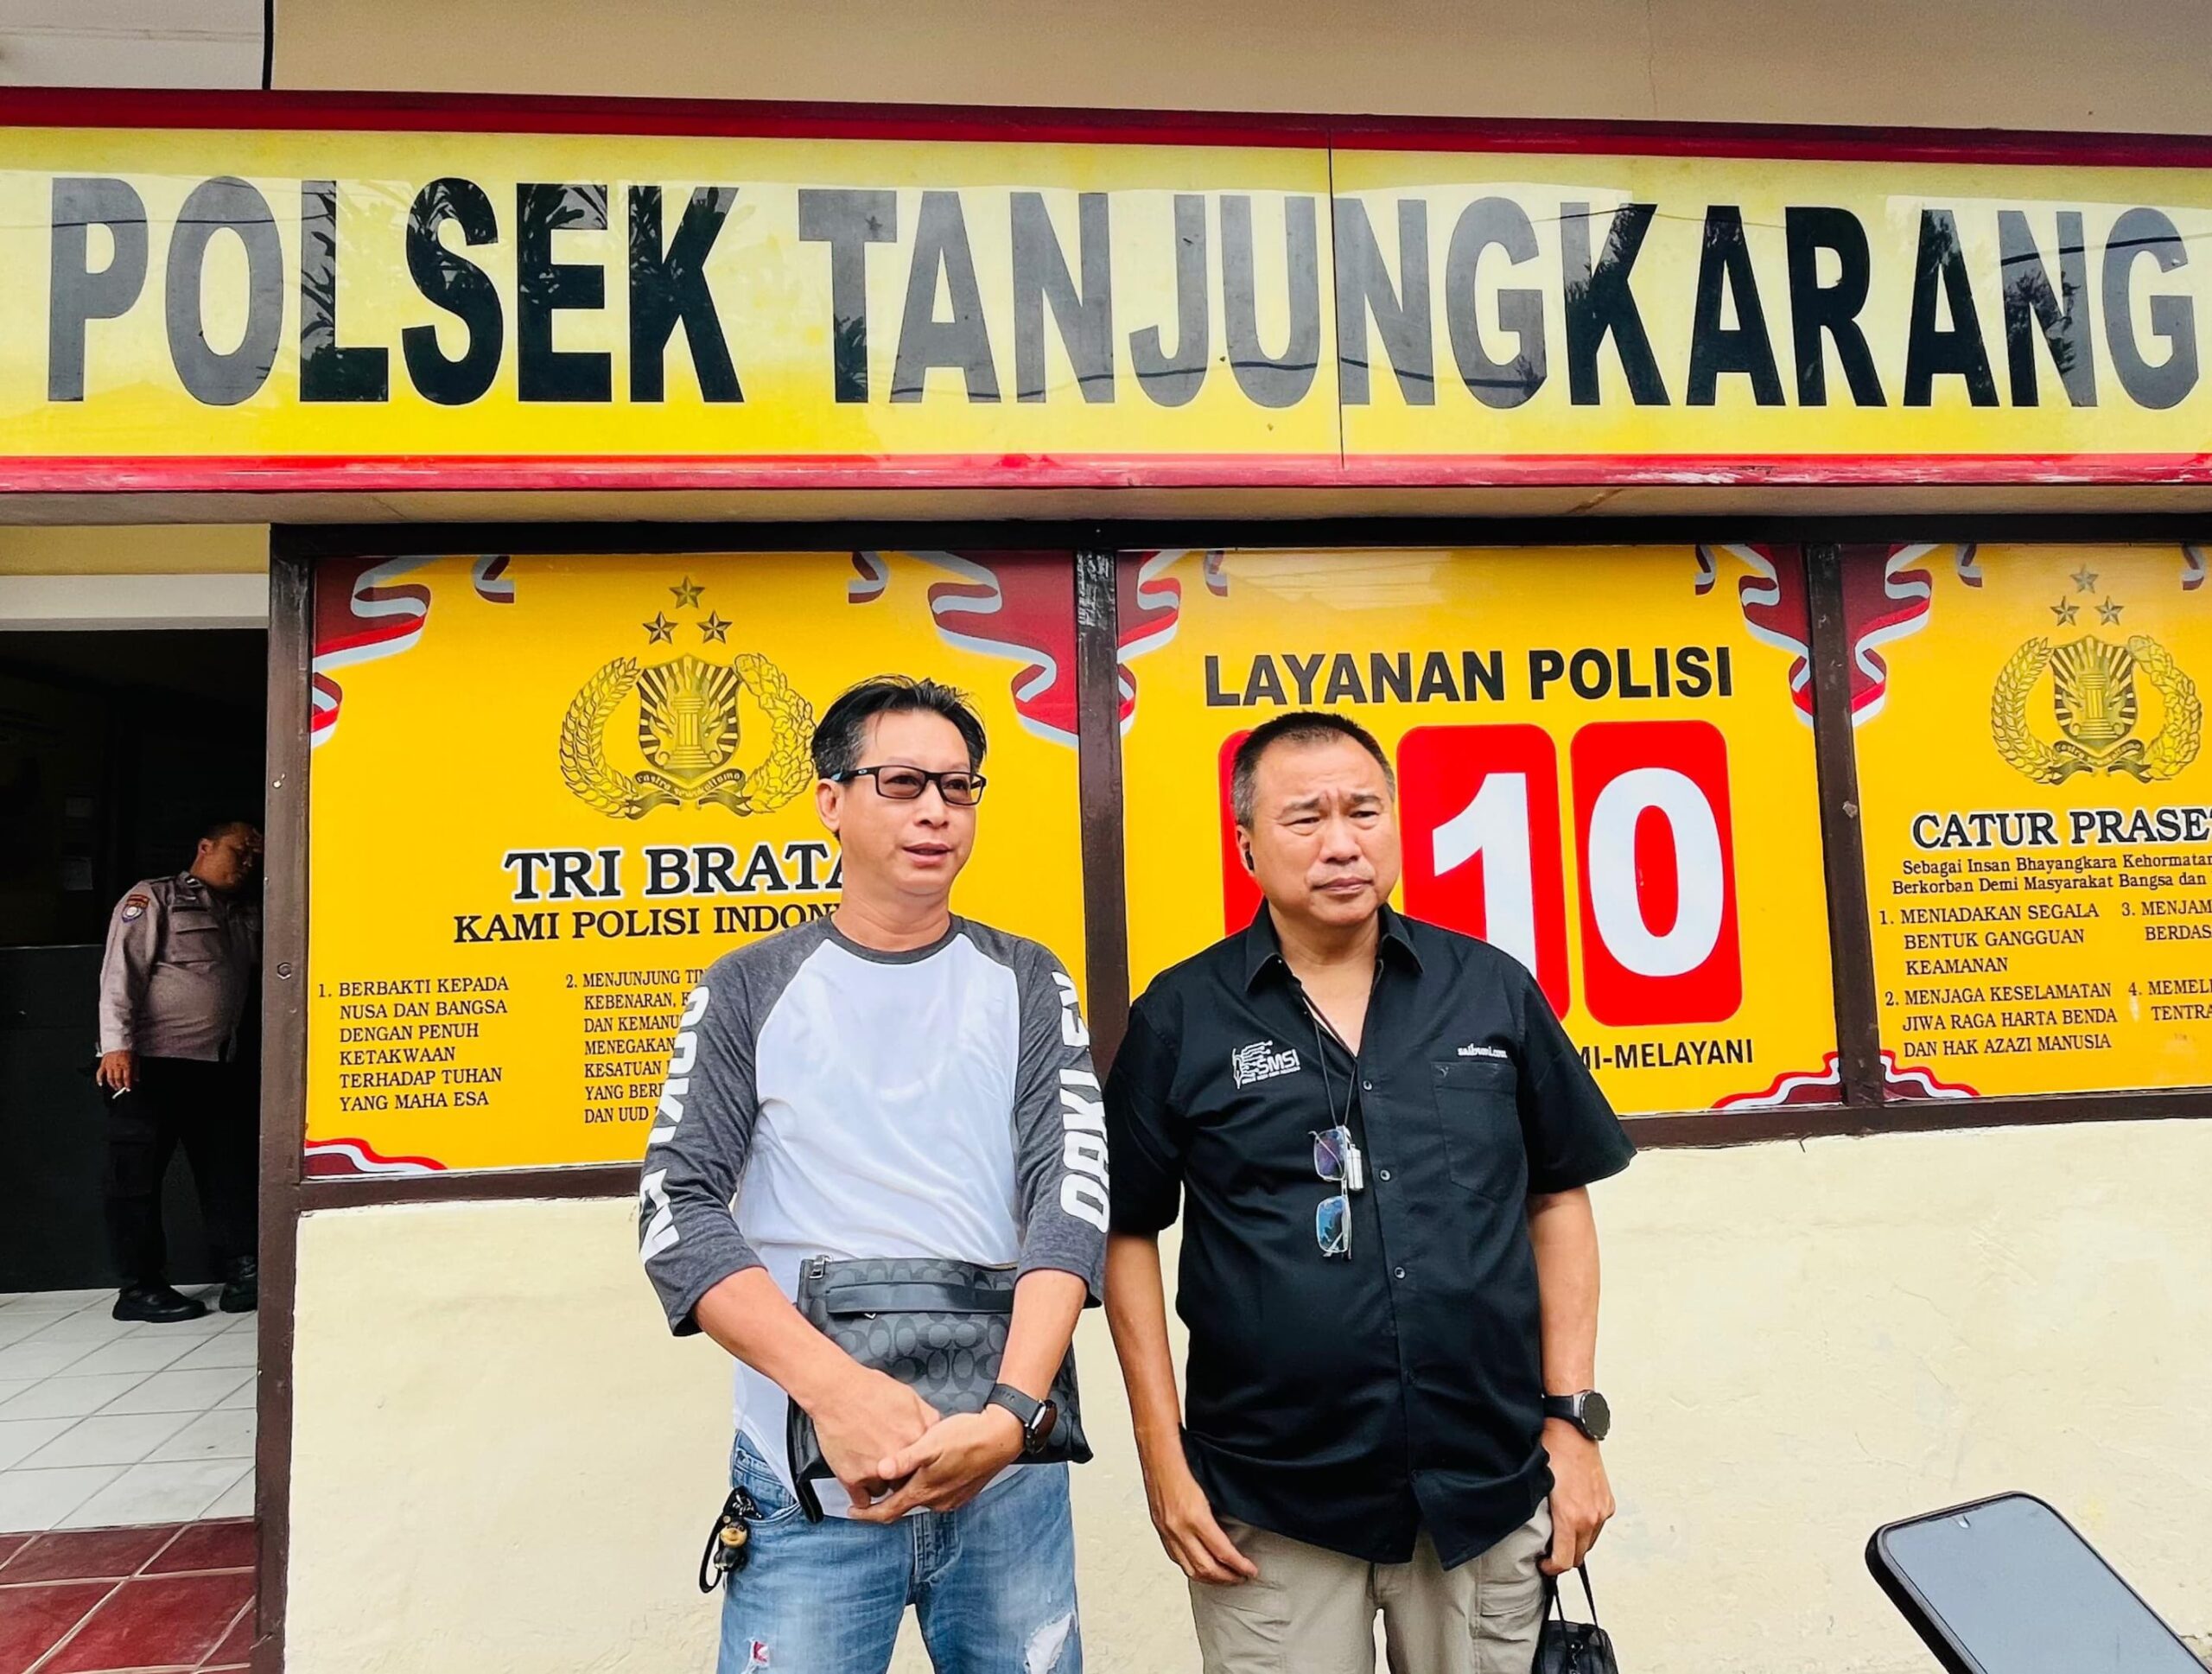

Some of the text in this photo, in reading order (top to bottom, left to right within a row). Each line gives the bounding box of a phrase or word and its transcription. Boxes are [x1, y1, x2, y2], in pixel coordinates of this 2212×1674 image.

[47, 175, 2200, 410] POLSEK TANJUNGKARANG
[1205, 647, 1732, 706] LAYANAN POLISI
[1913, 809, 2212, 848] CATUR PRASE
[505, 850, 620, 899] TRI
[1904, 860, 1961, 877] Sebagai
[1968, 859, 2010, 872] Insan
[2017, 856, 2116, 873] Bhayangkara
[1893, 872, 2206, 894] Berkorban Demi Masyarakat Bangsa dan
[1879, 904, 2099, 926] 1. MENIADAKAN SEGALA
[2121, 902, 2136, 916] 3.
[454, 903, 841, 943] KAMI POLISI INDON
[1904, 929, 2083, 949] BENTUK GANGGUAN
[1907, 958, 2006, 975] KEAMANAN
[318, 977, 508, 998] 1. BERBAKTI KEPADA
[566, 974, 578, 989] 2.
[584, 971, 679, 987] MENJUNJUNG
[2128, 982, 2143, 996] 4.
[584, 991, 677, 1010] KEBENARAN,
[1885, 983, 2110, 1007] 2. MENJAGA KESELAMATAN
[341, 1000, 507, 1019] NUSA DAN BANGSA
[585, 1018, 612, 1032] DAN
[1904, 1009, 2116, 1031] JIWA RAGA HARTA BENDA
[341, 1023, 478, 1042] DENGAN PENUH
[1904, 1034, 2110, 1057] DAN HAK AZAZI MANUSIA
[340, 1047, 454, 1065] KETAKWAAN
[1256, 1048, 1300, 1075] SMSI
[340, 1068, 501, 1087] TERHADAP TUHAN
[585, 1061, 661, 1078] KESATUAN
[340, 1092, 488, 1111] YANG MAHA ESA
[586, 1085, 623, 1100] YANG
[585, 1108, 613, 1123] DAN
[620, 1107, 648, 1121] UUD
